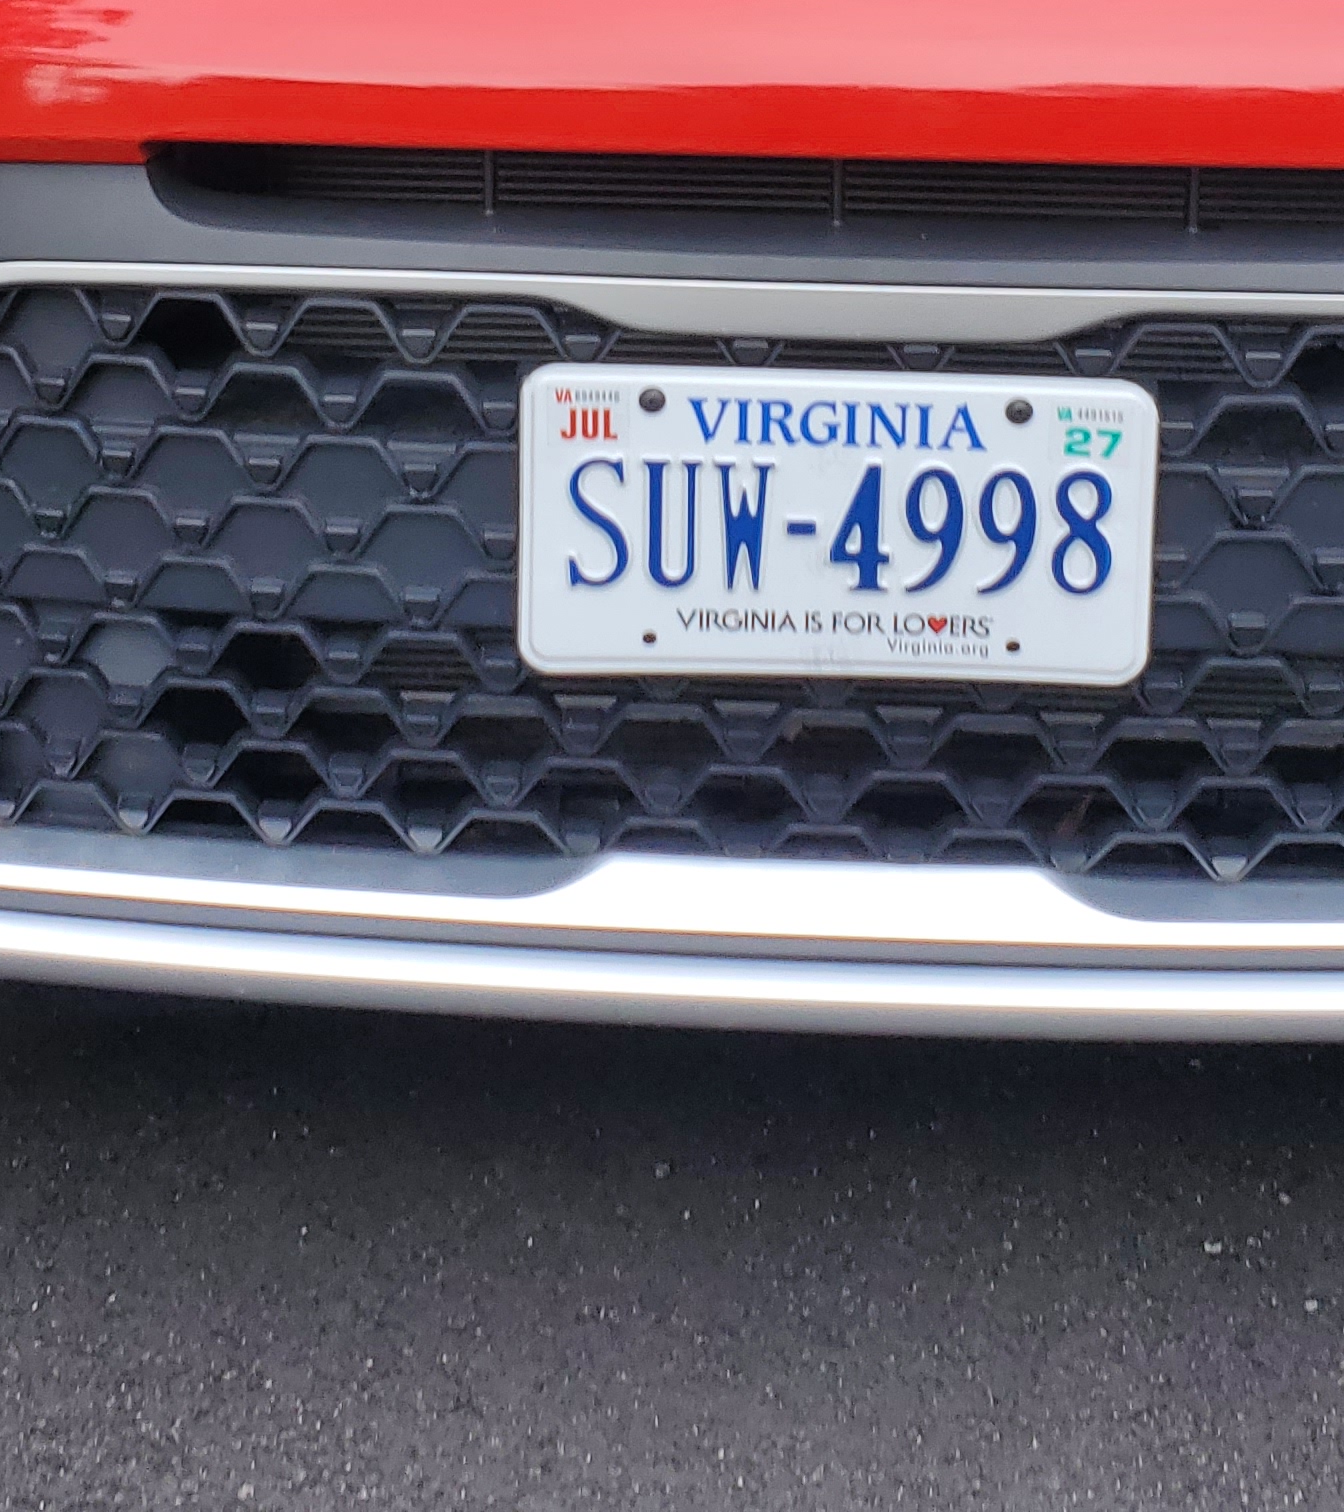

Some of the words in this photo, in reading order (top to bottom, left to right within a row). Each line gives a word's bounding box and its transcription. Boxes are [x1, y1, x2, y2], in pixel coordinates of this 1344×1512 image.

[555, 388, 573, 404] VA
[560, 408, 619, 441] JUL
[687, 397, 987, 451] VIRGINIA
[1063, 427, 1123, 459] 27
[567, 456, 1114, 595] SUW-4998
[676, 607, 797, 633] VIRGINIA
[805, 610, 823, 633] IS
[831, 611, 885, 635] FOR
[887, 637, 990, 659] Virginia.org
